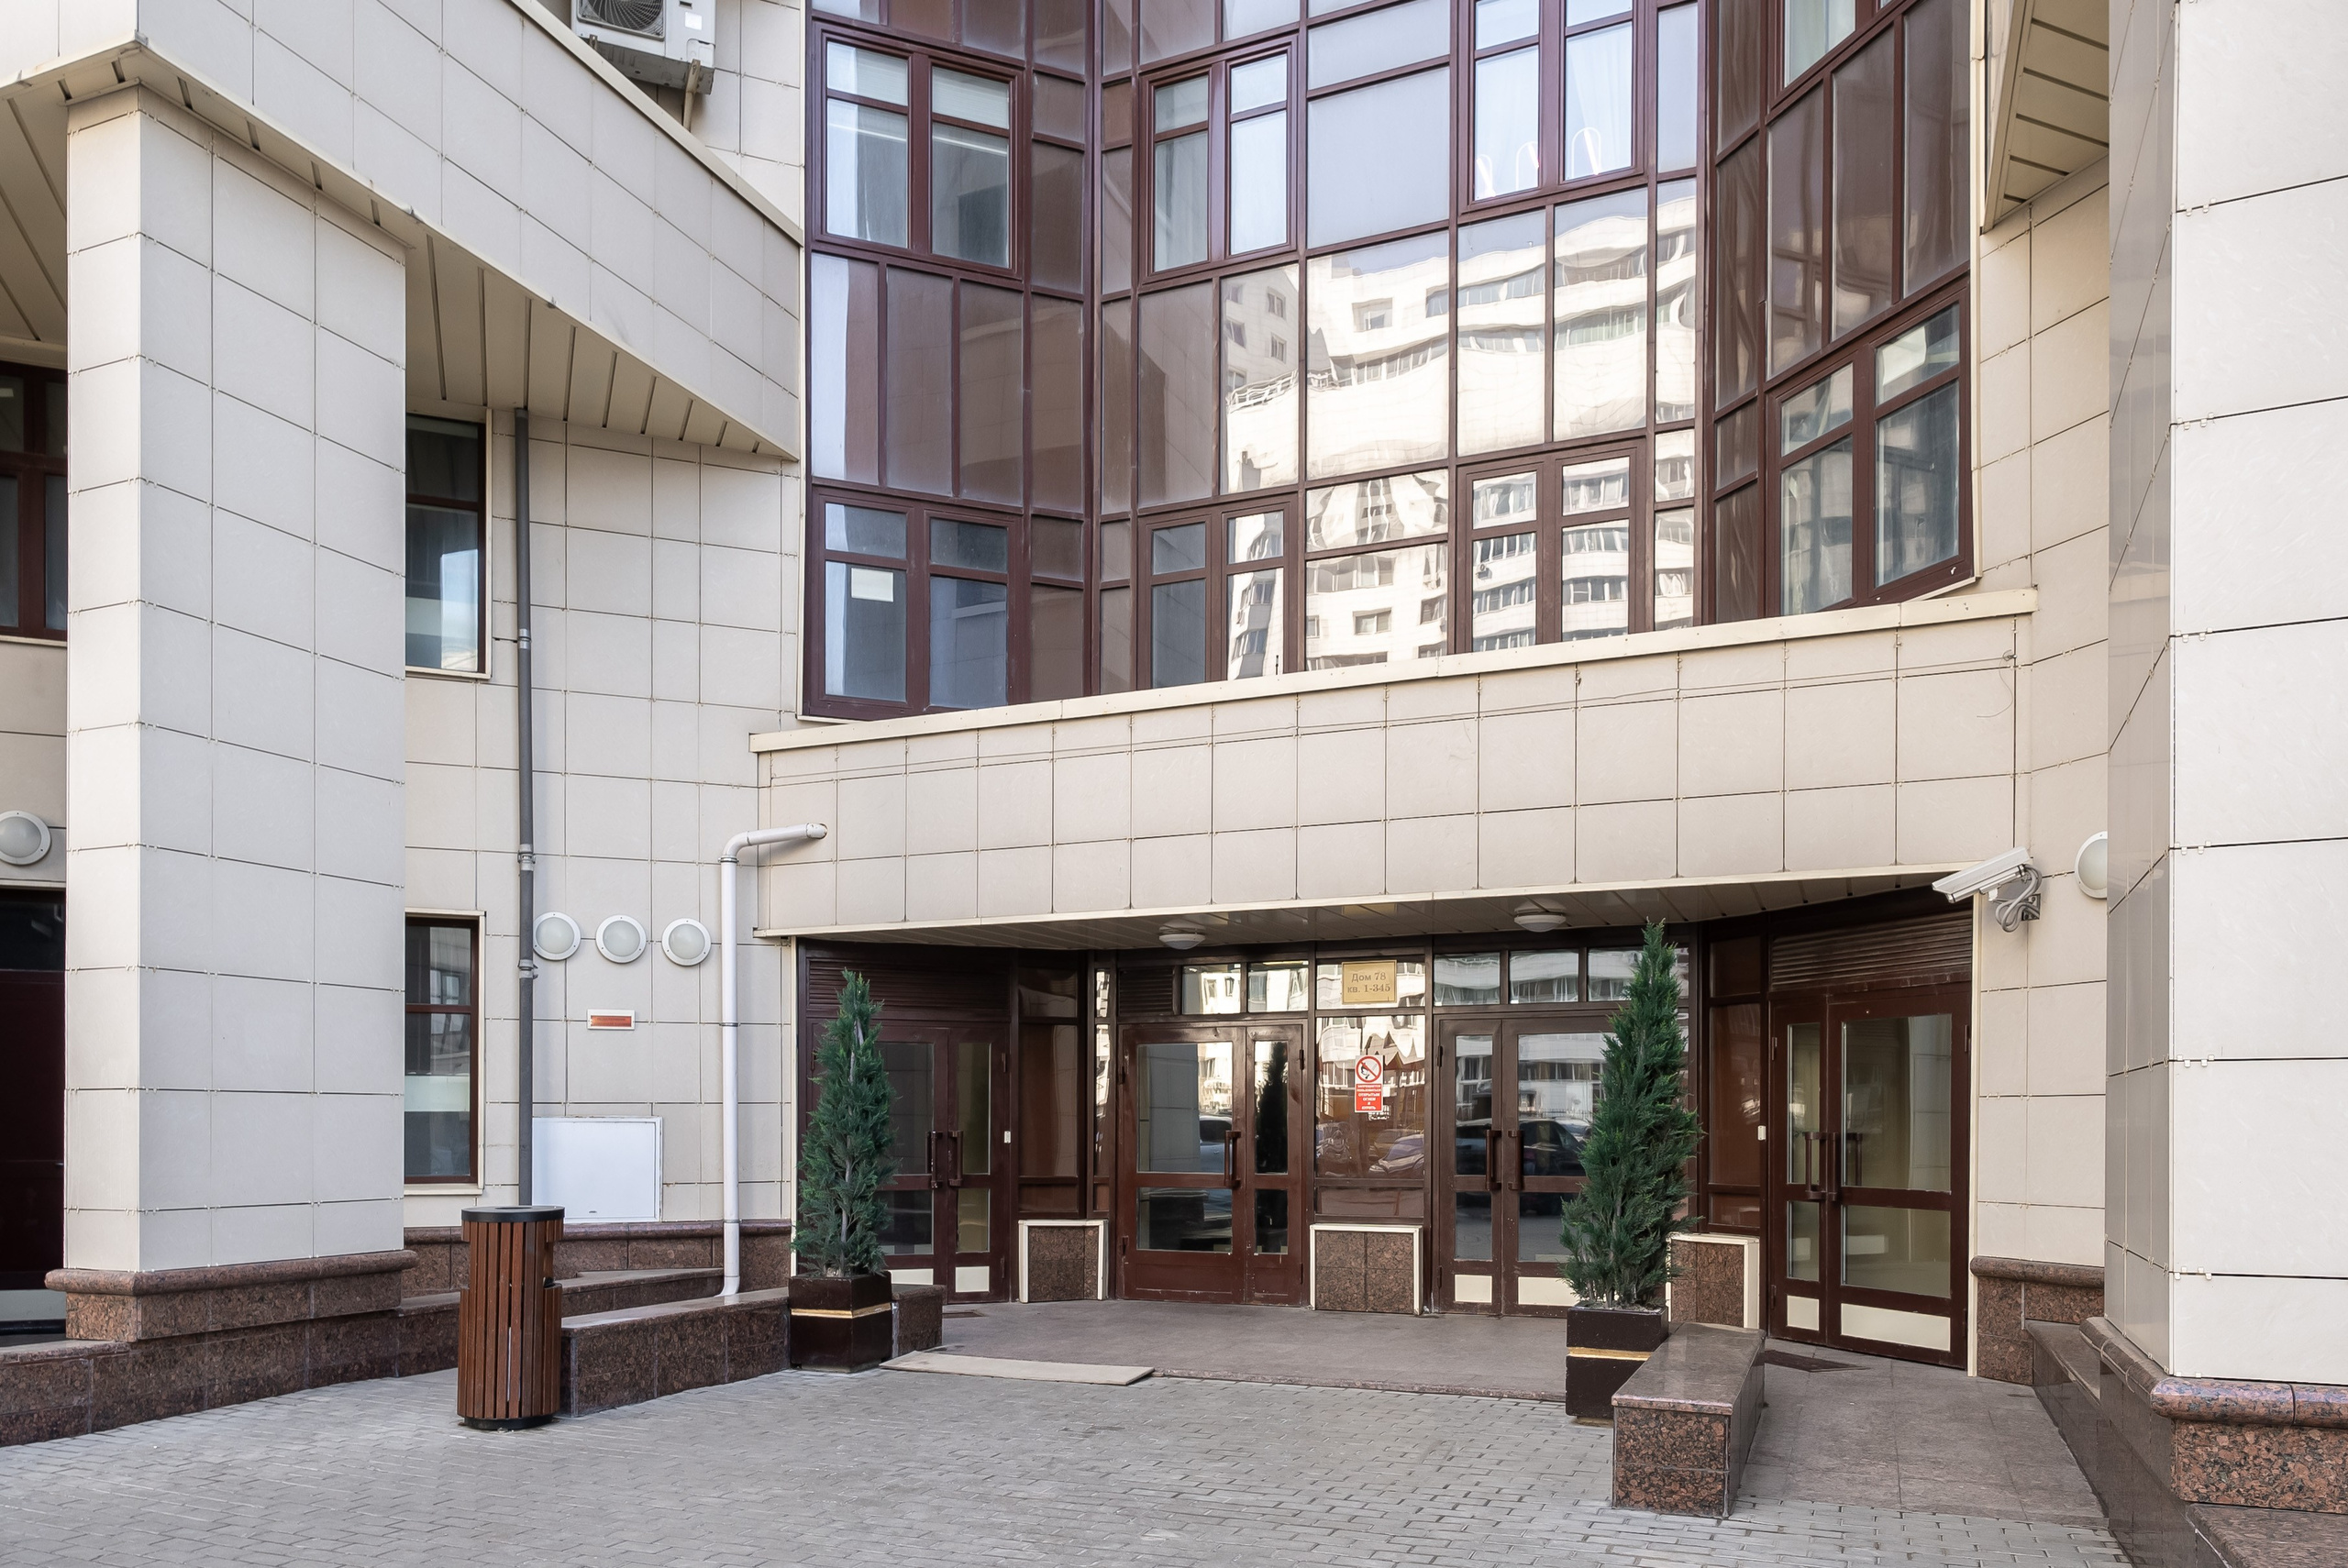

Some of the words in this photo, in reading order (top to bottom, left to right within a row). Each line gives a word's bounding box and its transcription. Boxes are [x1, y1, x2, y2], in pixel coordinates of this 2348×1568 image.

[1351, 973, 1372, 983] Дом
[1374, 972, 1386, 981] 78
[1364, 983, 1391, 993] 1-345
